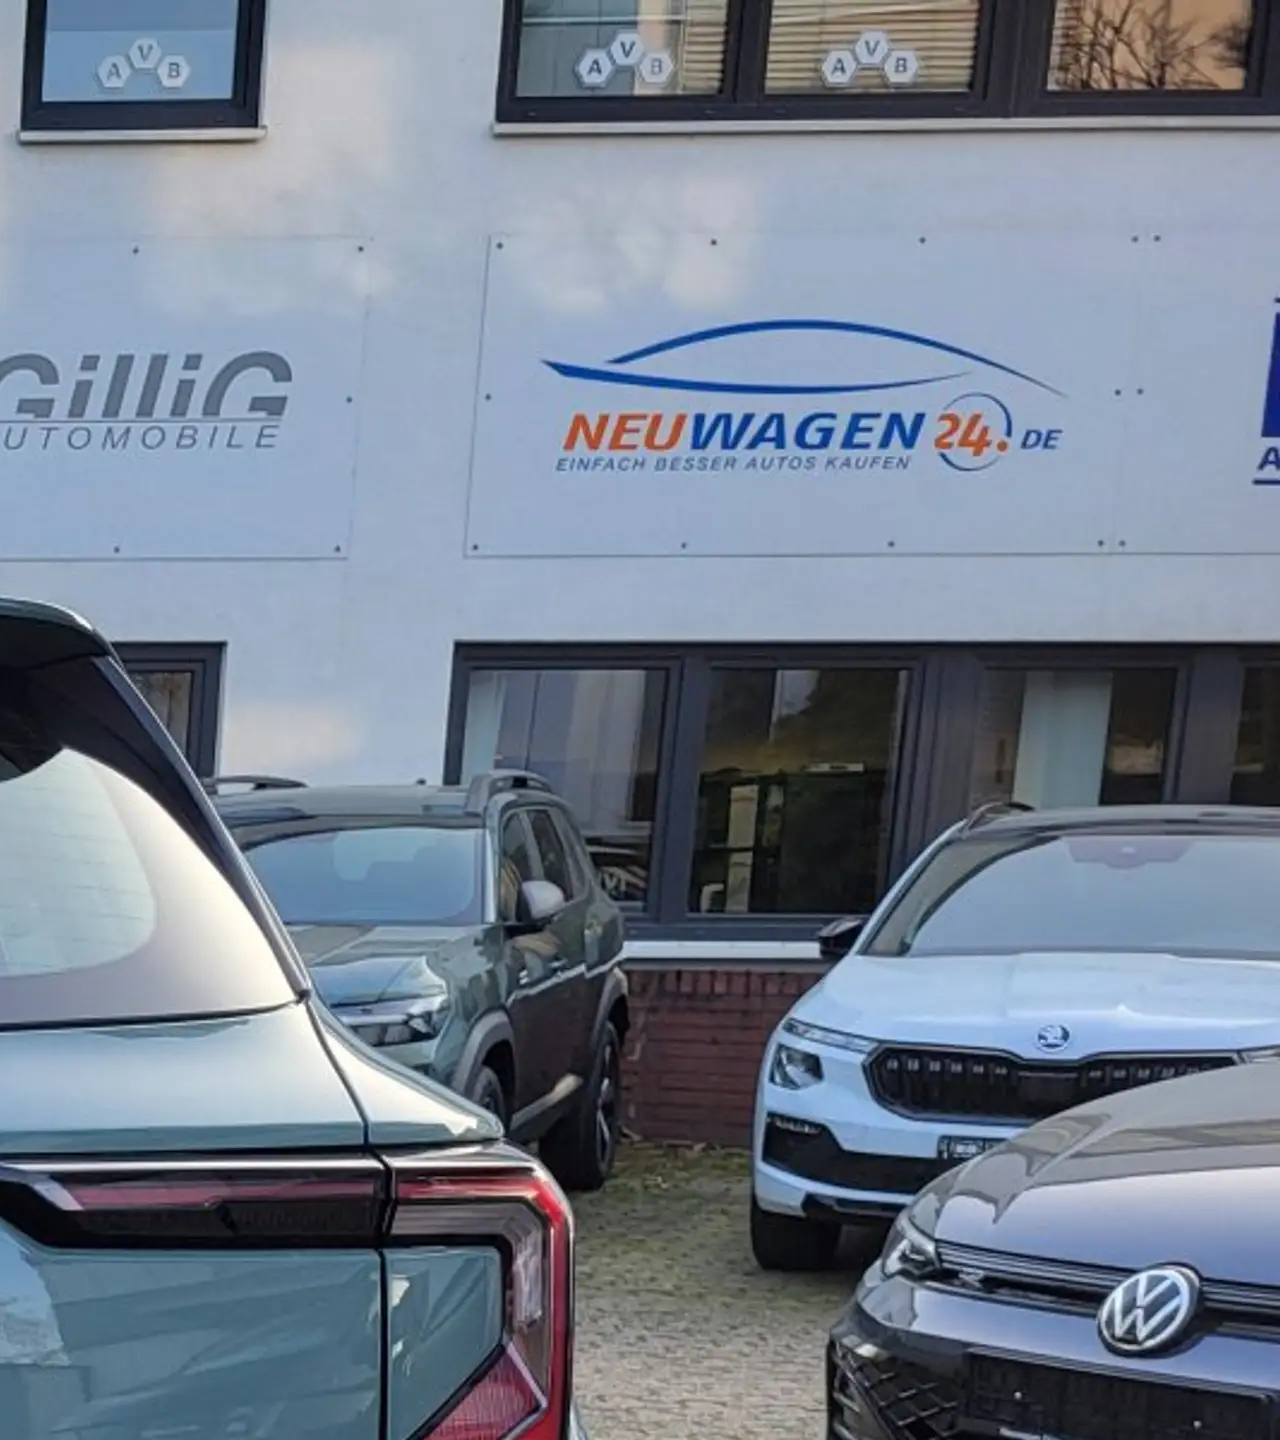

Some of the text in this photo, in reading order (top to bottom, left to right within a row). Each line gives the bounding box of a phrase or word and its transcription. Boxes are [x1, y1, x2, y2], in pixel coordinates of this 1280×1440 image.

[554, 455, 911, 473] EINFACH BESSER AUTOS KAUFEN
